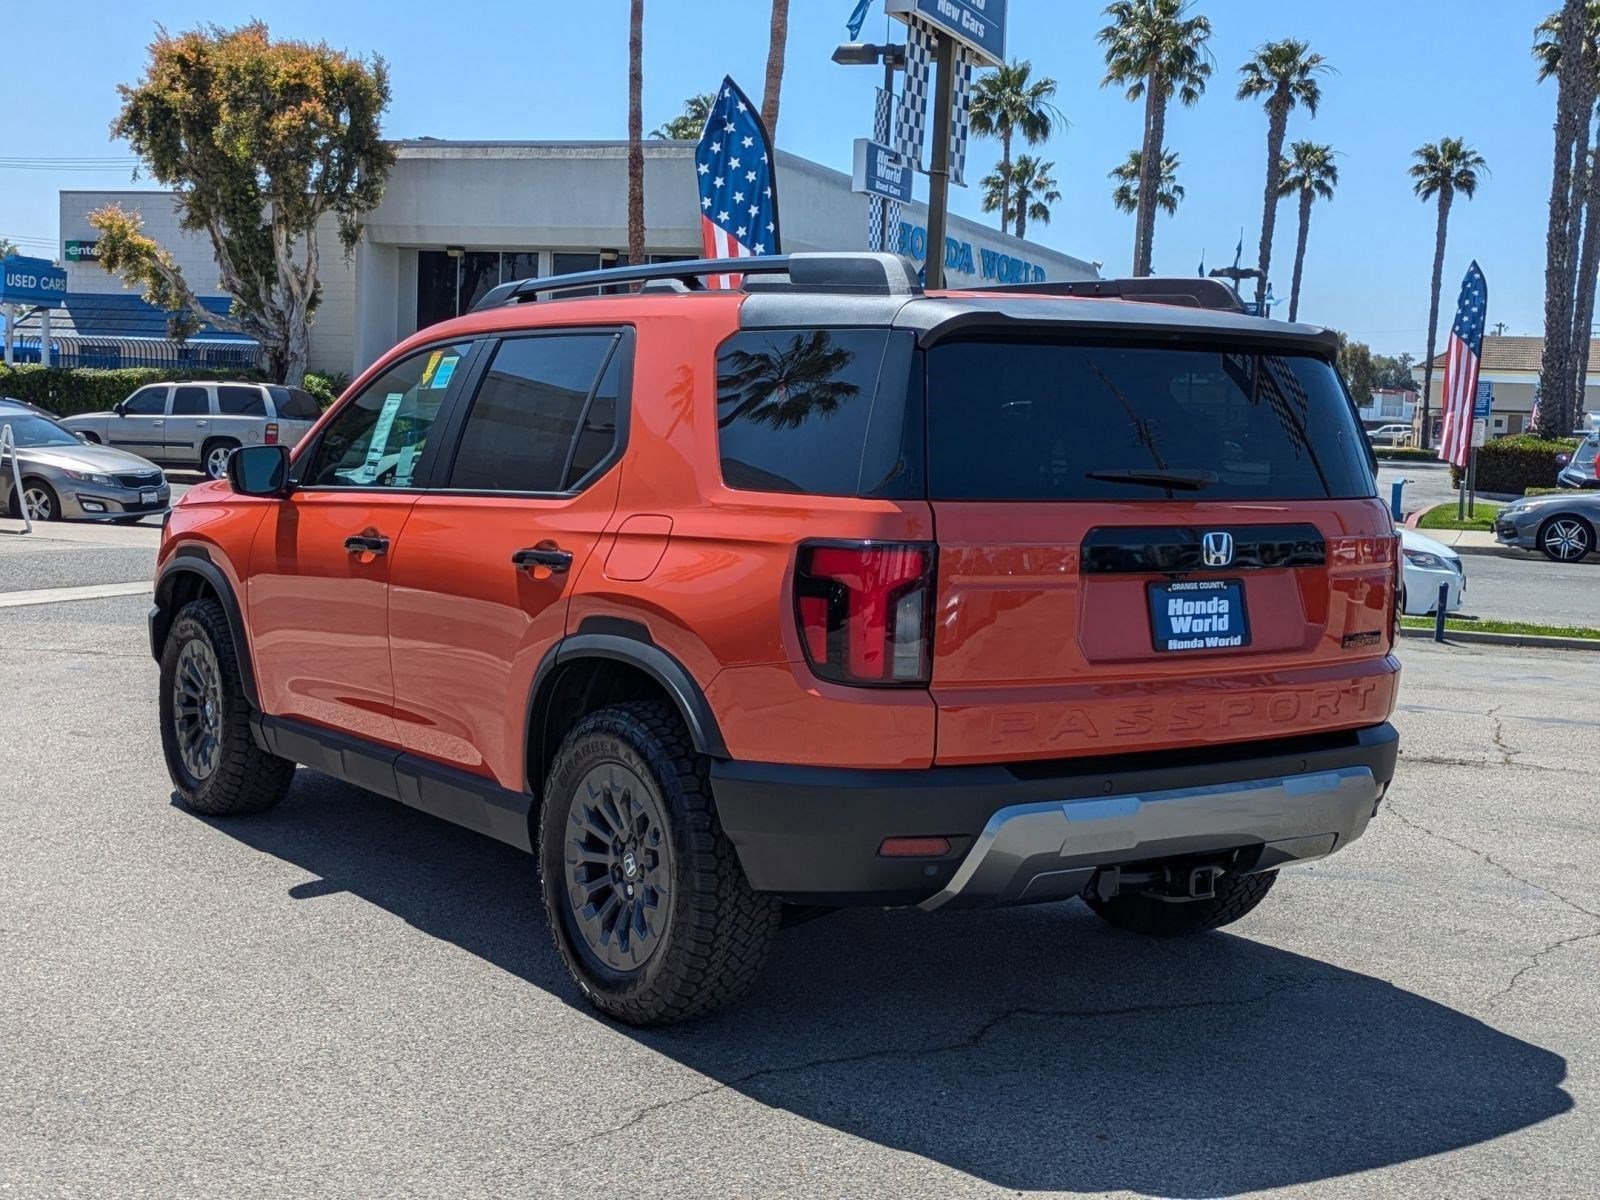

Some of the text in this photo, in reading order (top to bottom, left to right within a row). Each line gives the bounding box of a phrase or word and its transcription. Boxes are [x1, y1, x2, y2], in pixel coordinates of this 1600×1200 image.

[962, 9, 985, 38] Cars
[877, 163, 902, 184] World
[68, 245, 101, 257] ente
[899, 222, 1046, 283] HODA WORLD
[6, 273, 66, 291] USED CARS
[1171, 581, 1225, 591] ORANGE COUNTY
[1168, 596, 1229, 616] Honda
[1170, 614, 1229, 634] World
[1168, 635, 1242, 650] Honda World
[990, 682, 1376, 744] PASSPORT
